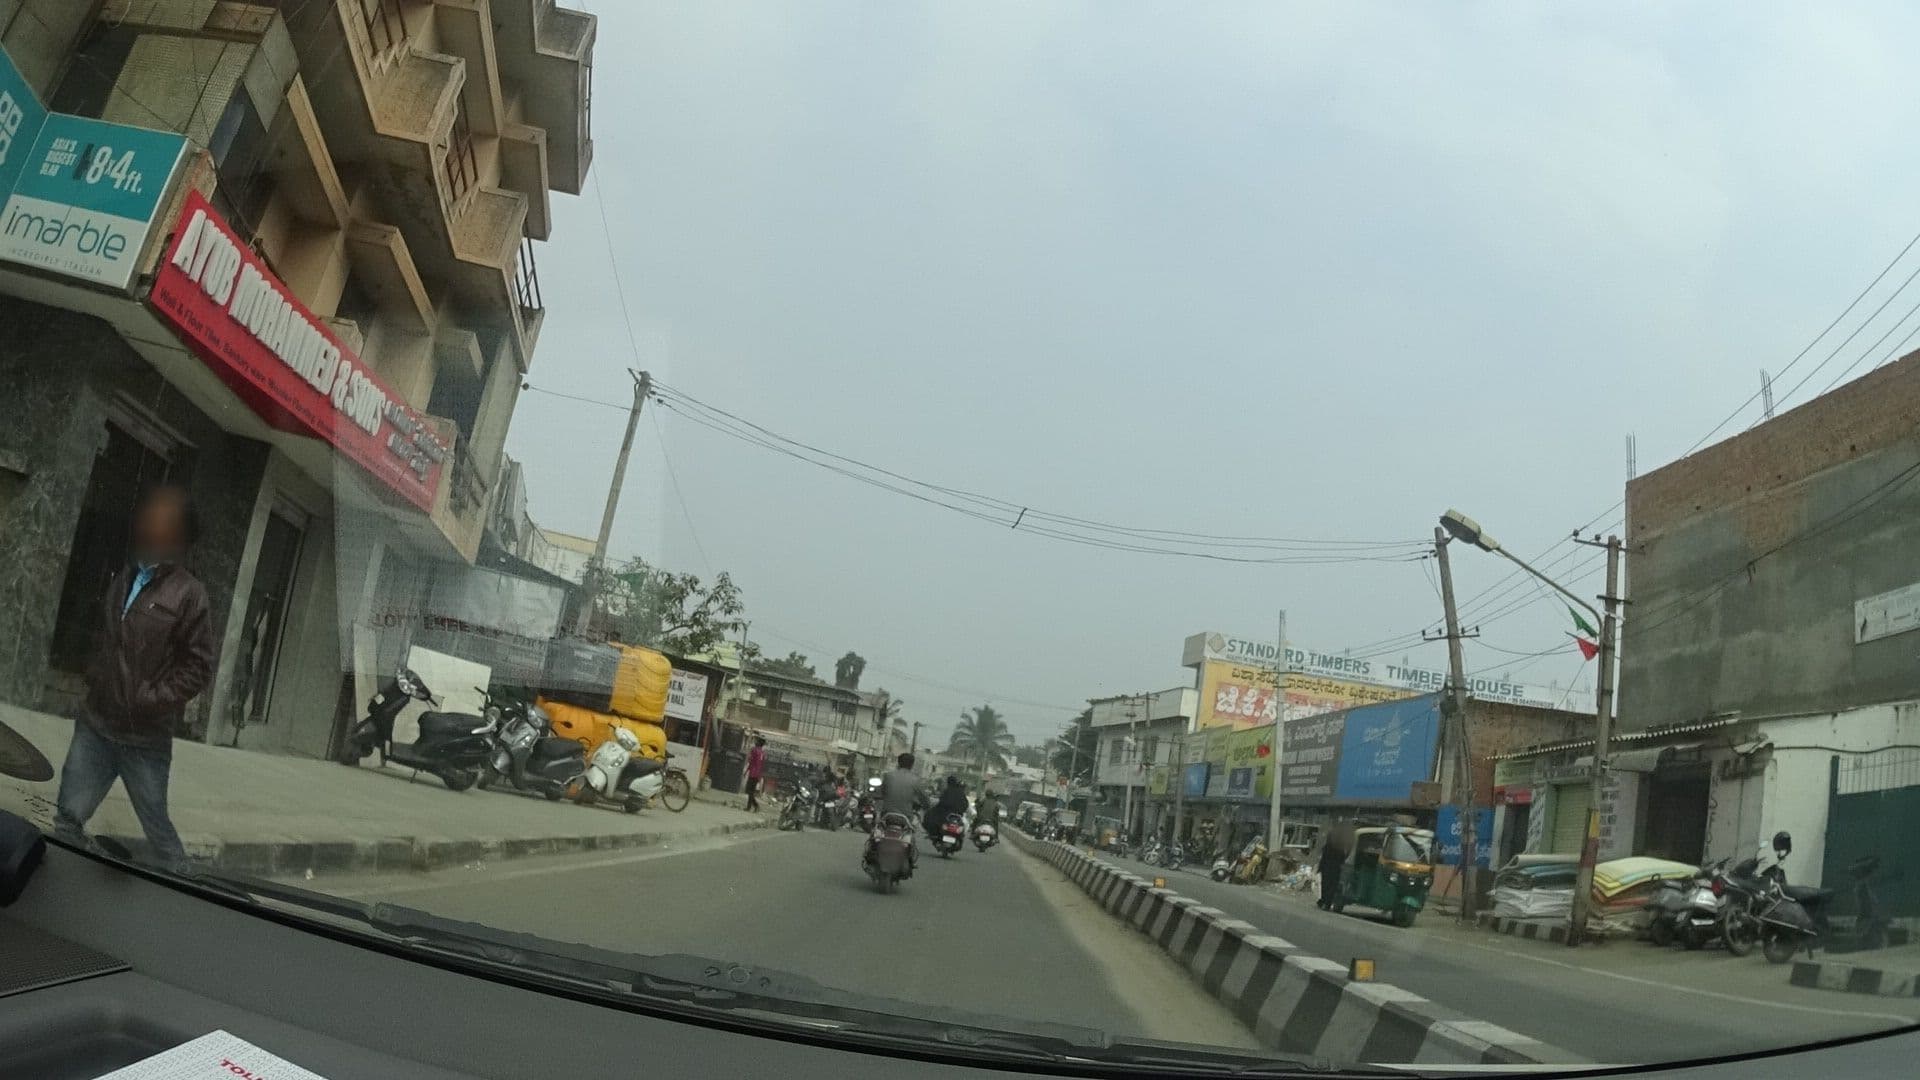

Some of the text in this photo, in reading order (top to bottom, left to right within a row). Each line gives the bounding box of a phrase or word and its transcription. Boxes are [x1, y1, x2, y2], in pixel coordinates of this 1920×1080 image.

[4, 205, 127, 261] imarble
[63, 260, 103, 277] ITALIAN
[172, 209, 242, 306] AYUB
[228, 263, 341, 396] MOHAMMED
[330, 360, 352, 411] &
[346, 370, 386, 437] SONS
[1227, 638, 1305, 665] STANDARD
[1308, 652, 1372, 675] TIMBERS
